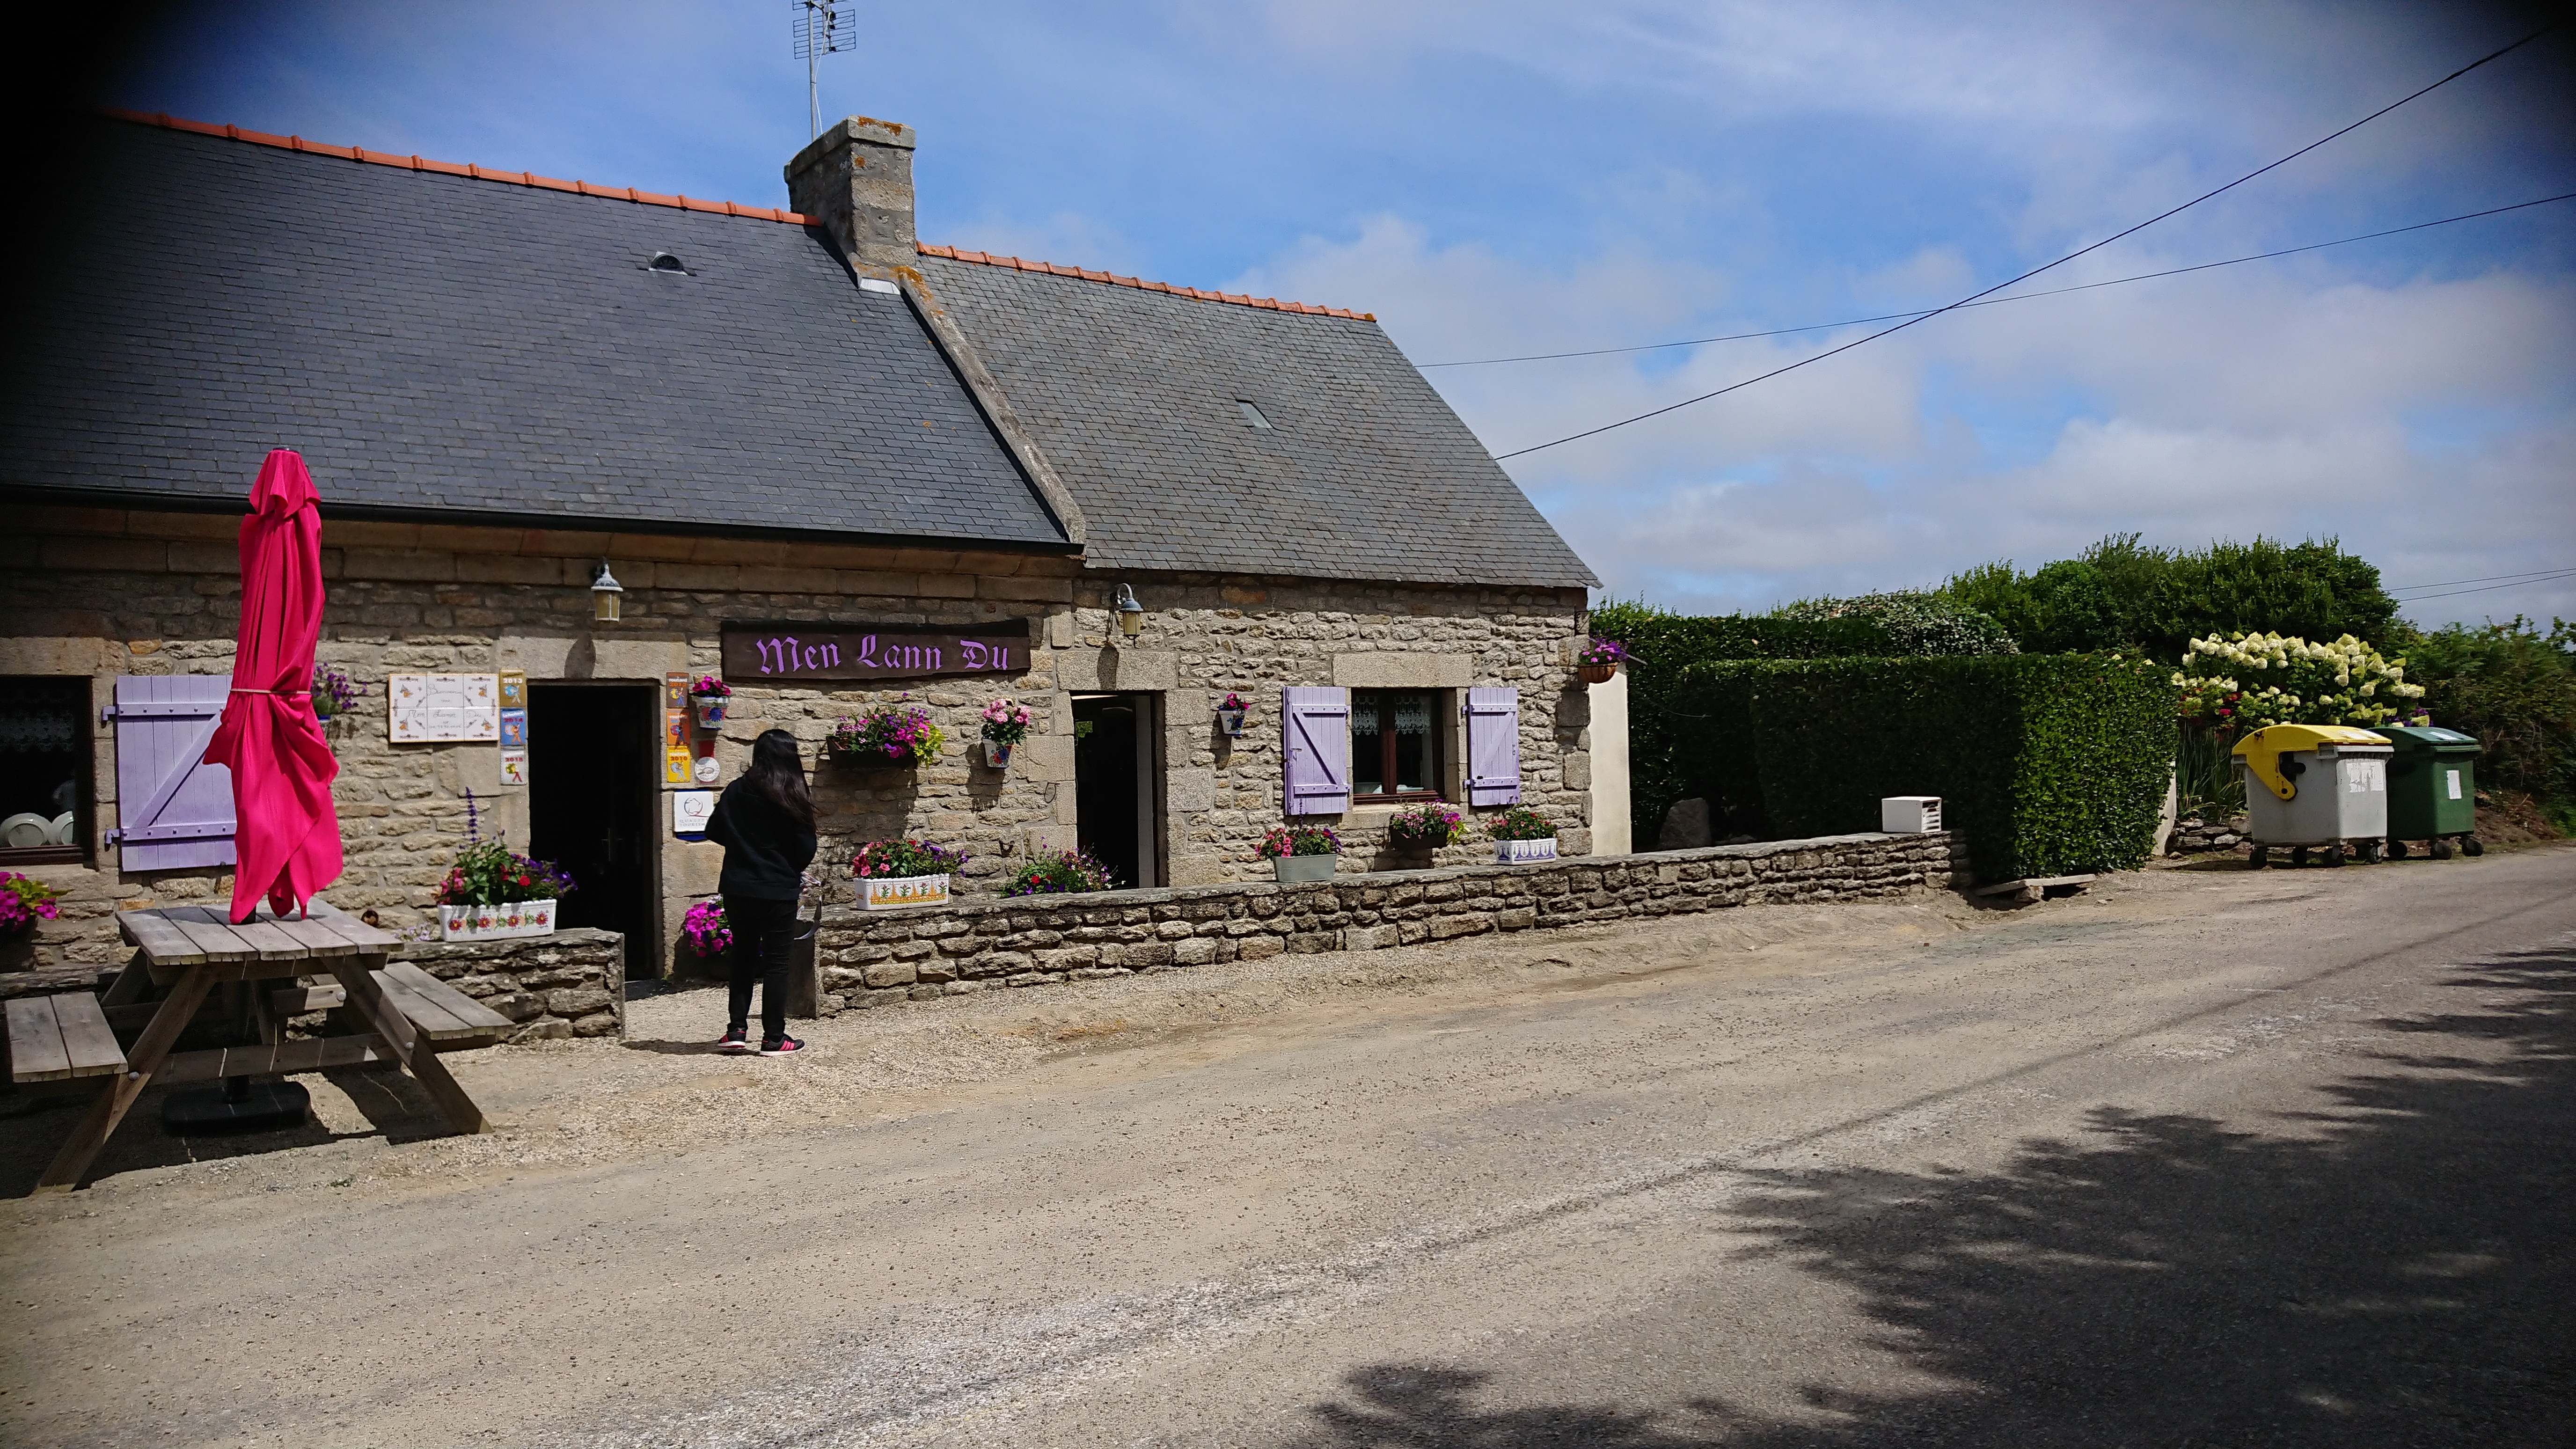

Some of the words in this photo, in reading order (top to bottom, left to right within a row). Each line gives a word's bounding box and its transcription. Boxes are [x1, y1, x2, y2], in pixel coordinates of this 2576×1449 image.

[755, 636, 842, 675] Men
[857, 633, 943, 671] Lann
[960, 638, 1008, 671] Du
